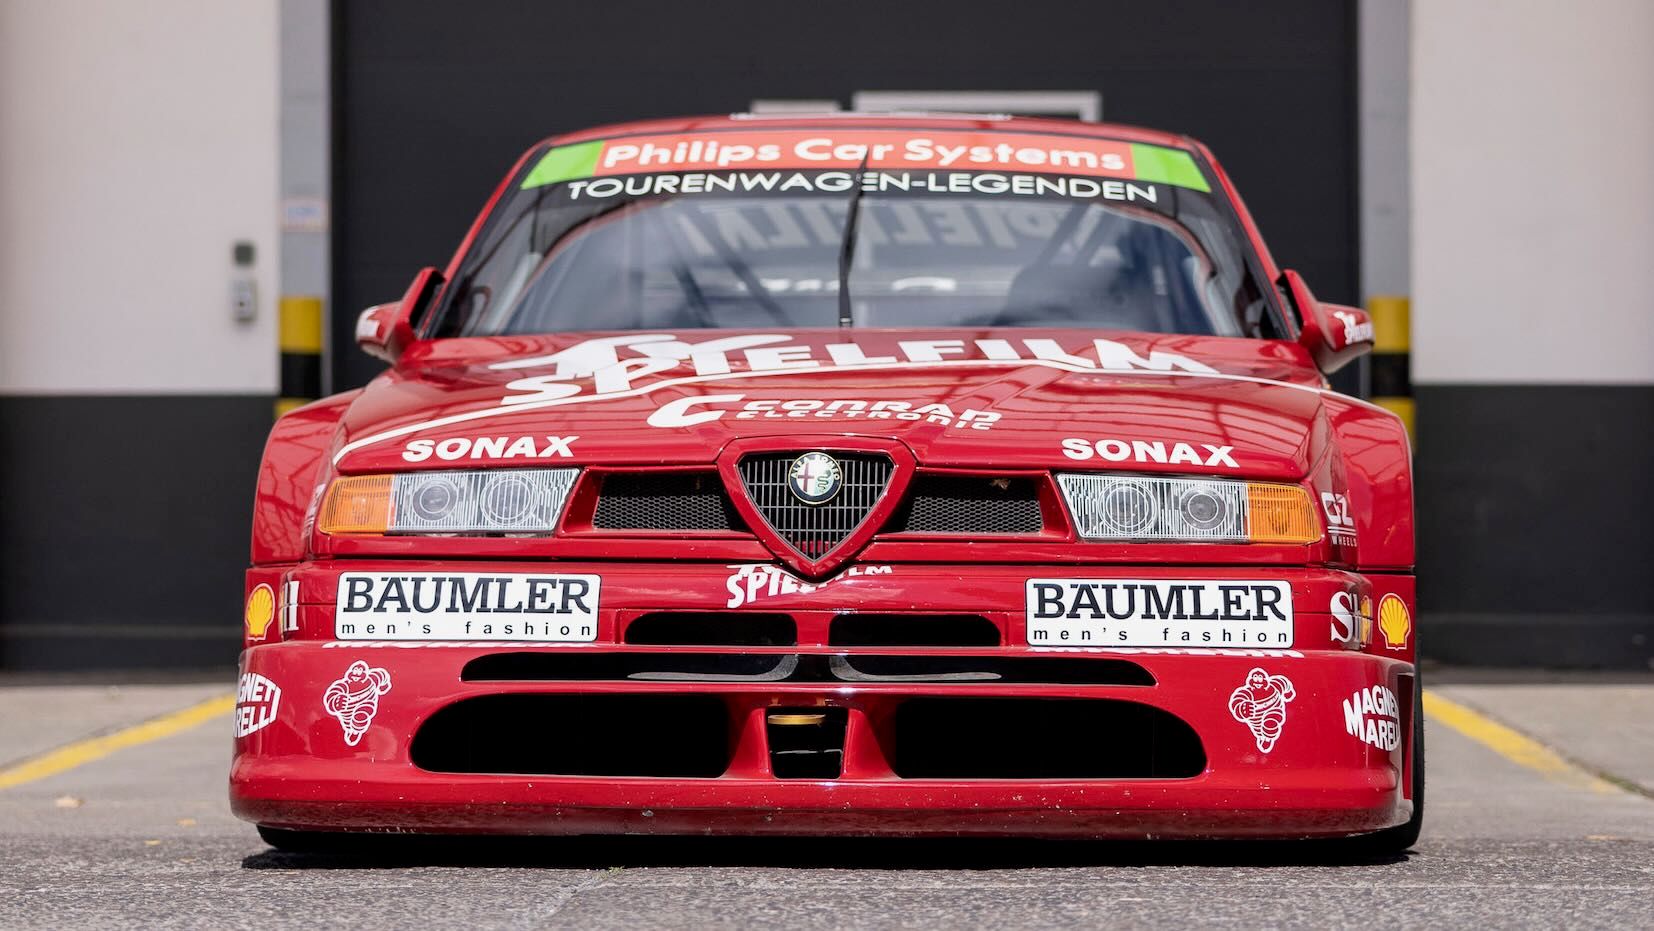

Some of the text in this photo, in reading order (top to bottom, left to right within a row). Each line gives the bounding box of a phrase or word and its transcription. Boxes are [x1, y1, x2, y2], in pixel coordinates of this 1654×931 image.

[603, 138, 1125, 171] Philips Car Systems
[568, 172, 1157, 203] TOURENWAGEN-LEGENDEN
[402, 435, 580, 463] SONAX
[1061, 437, 1240, 468] SONAX
[342, 576, 591, 615] BÄUMLER
[1033, 583, 1287, 621] BÄUMLER
[341, 621, 591, 636] men's fashion
[1033, 628, 1288, 643] men's fashion
